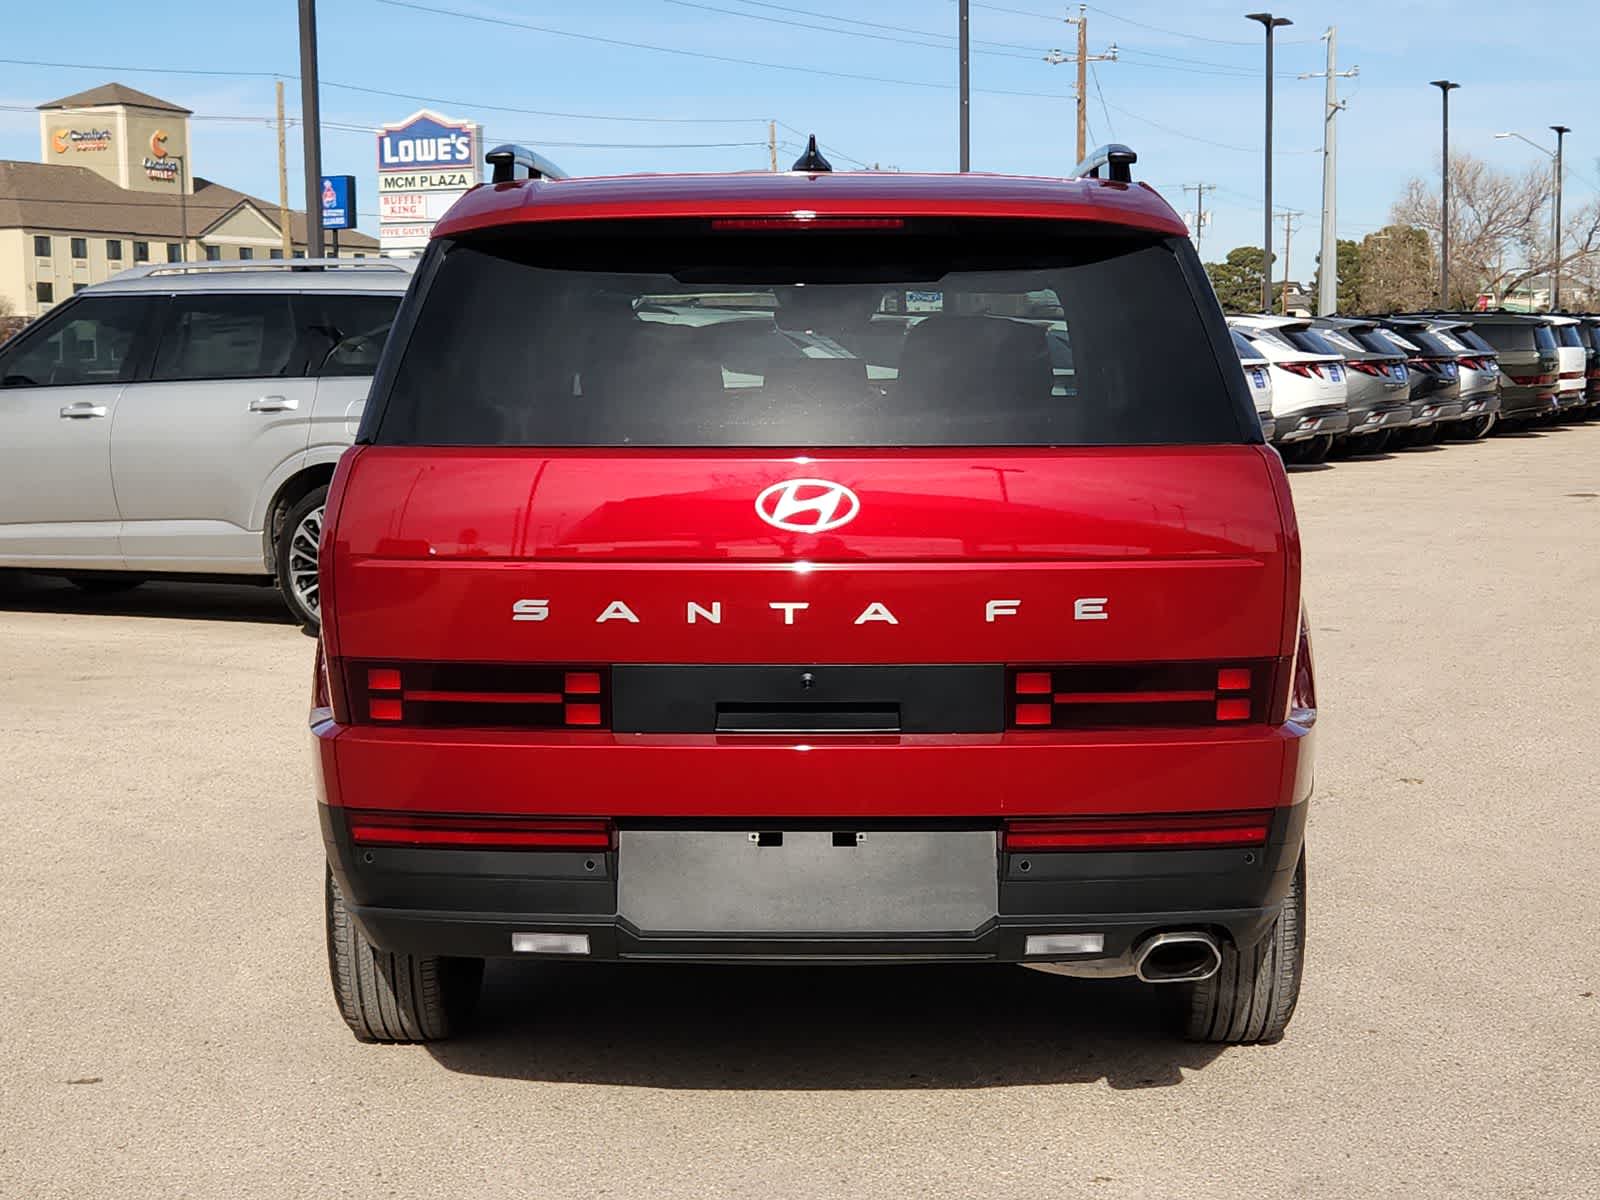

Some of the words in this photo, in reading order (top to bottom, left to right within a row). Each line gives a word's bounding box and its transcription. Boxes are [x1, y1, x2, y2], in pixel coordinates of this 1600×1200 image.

[383, 134, 470, 163] LOWE'S
[384, 176, 416, 188] MCM
[421, 174, 468, 187] PLAZA
[383, 195, 422, 206] BUFFET
[390, 206, 417, 215] KING
[511, 599, 899, 625] SANTA
[985, 598, 1108, 622] FE
